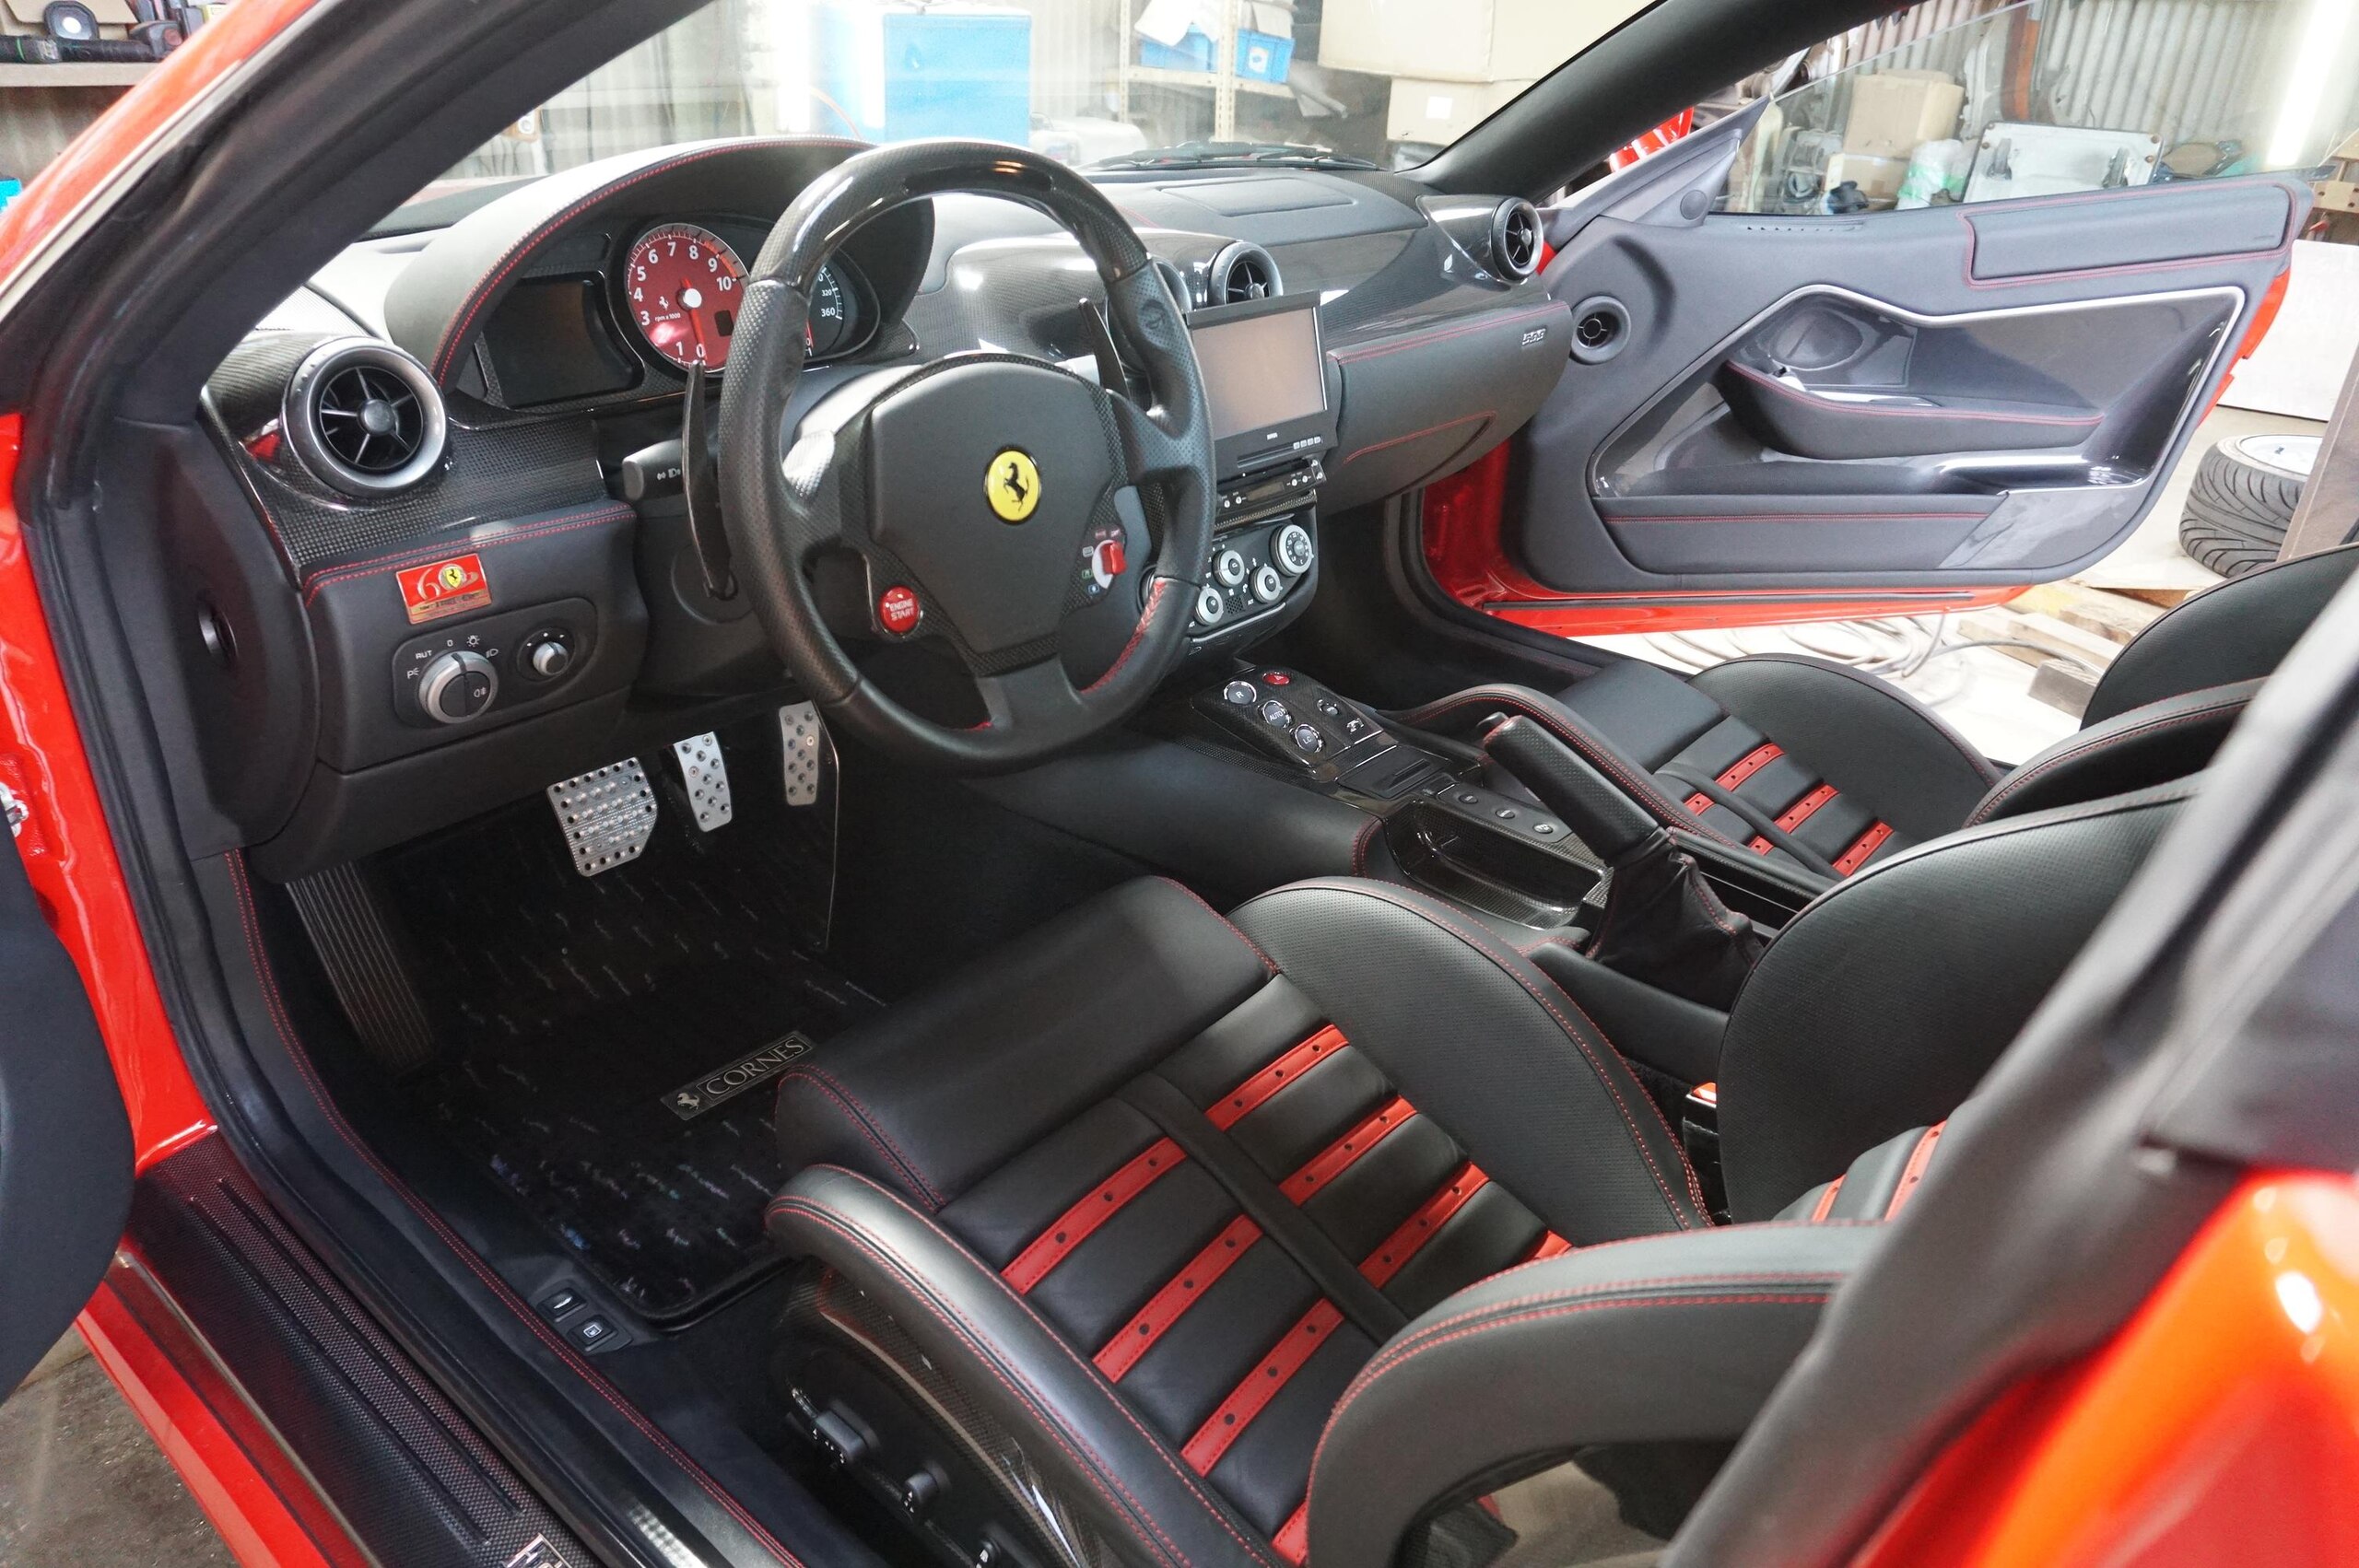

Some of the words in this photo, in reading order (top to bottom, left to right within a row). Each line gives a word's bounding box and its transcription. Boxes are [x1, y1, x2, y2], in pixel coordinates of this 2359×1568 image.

[648, 249, 659, 263] 6
[667, 241, 676, 256] 7
[688, 244, 699, 260] 8
[708, 257, 718, 272] 9
[637, 265, 647, 281] 5
[716, 276, 732, 291] 10
[633, 287, 643, 302] 4
[640, 310, 650, 325] 3
[820, 307, 836, 318] 360
[675, 341, 684, 357] 1
[696, 343, 706, 357] 0
[889, 598, 913, 612] ENGINE
[891, 608, 914, 621] START
[1235, 690, 1243, 698] R
[1269, 710, 1284, 720] AUTO
[1302, 735, 1311, 744] LC
[706, 1038, 804, 1094] CORNES
